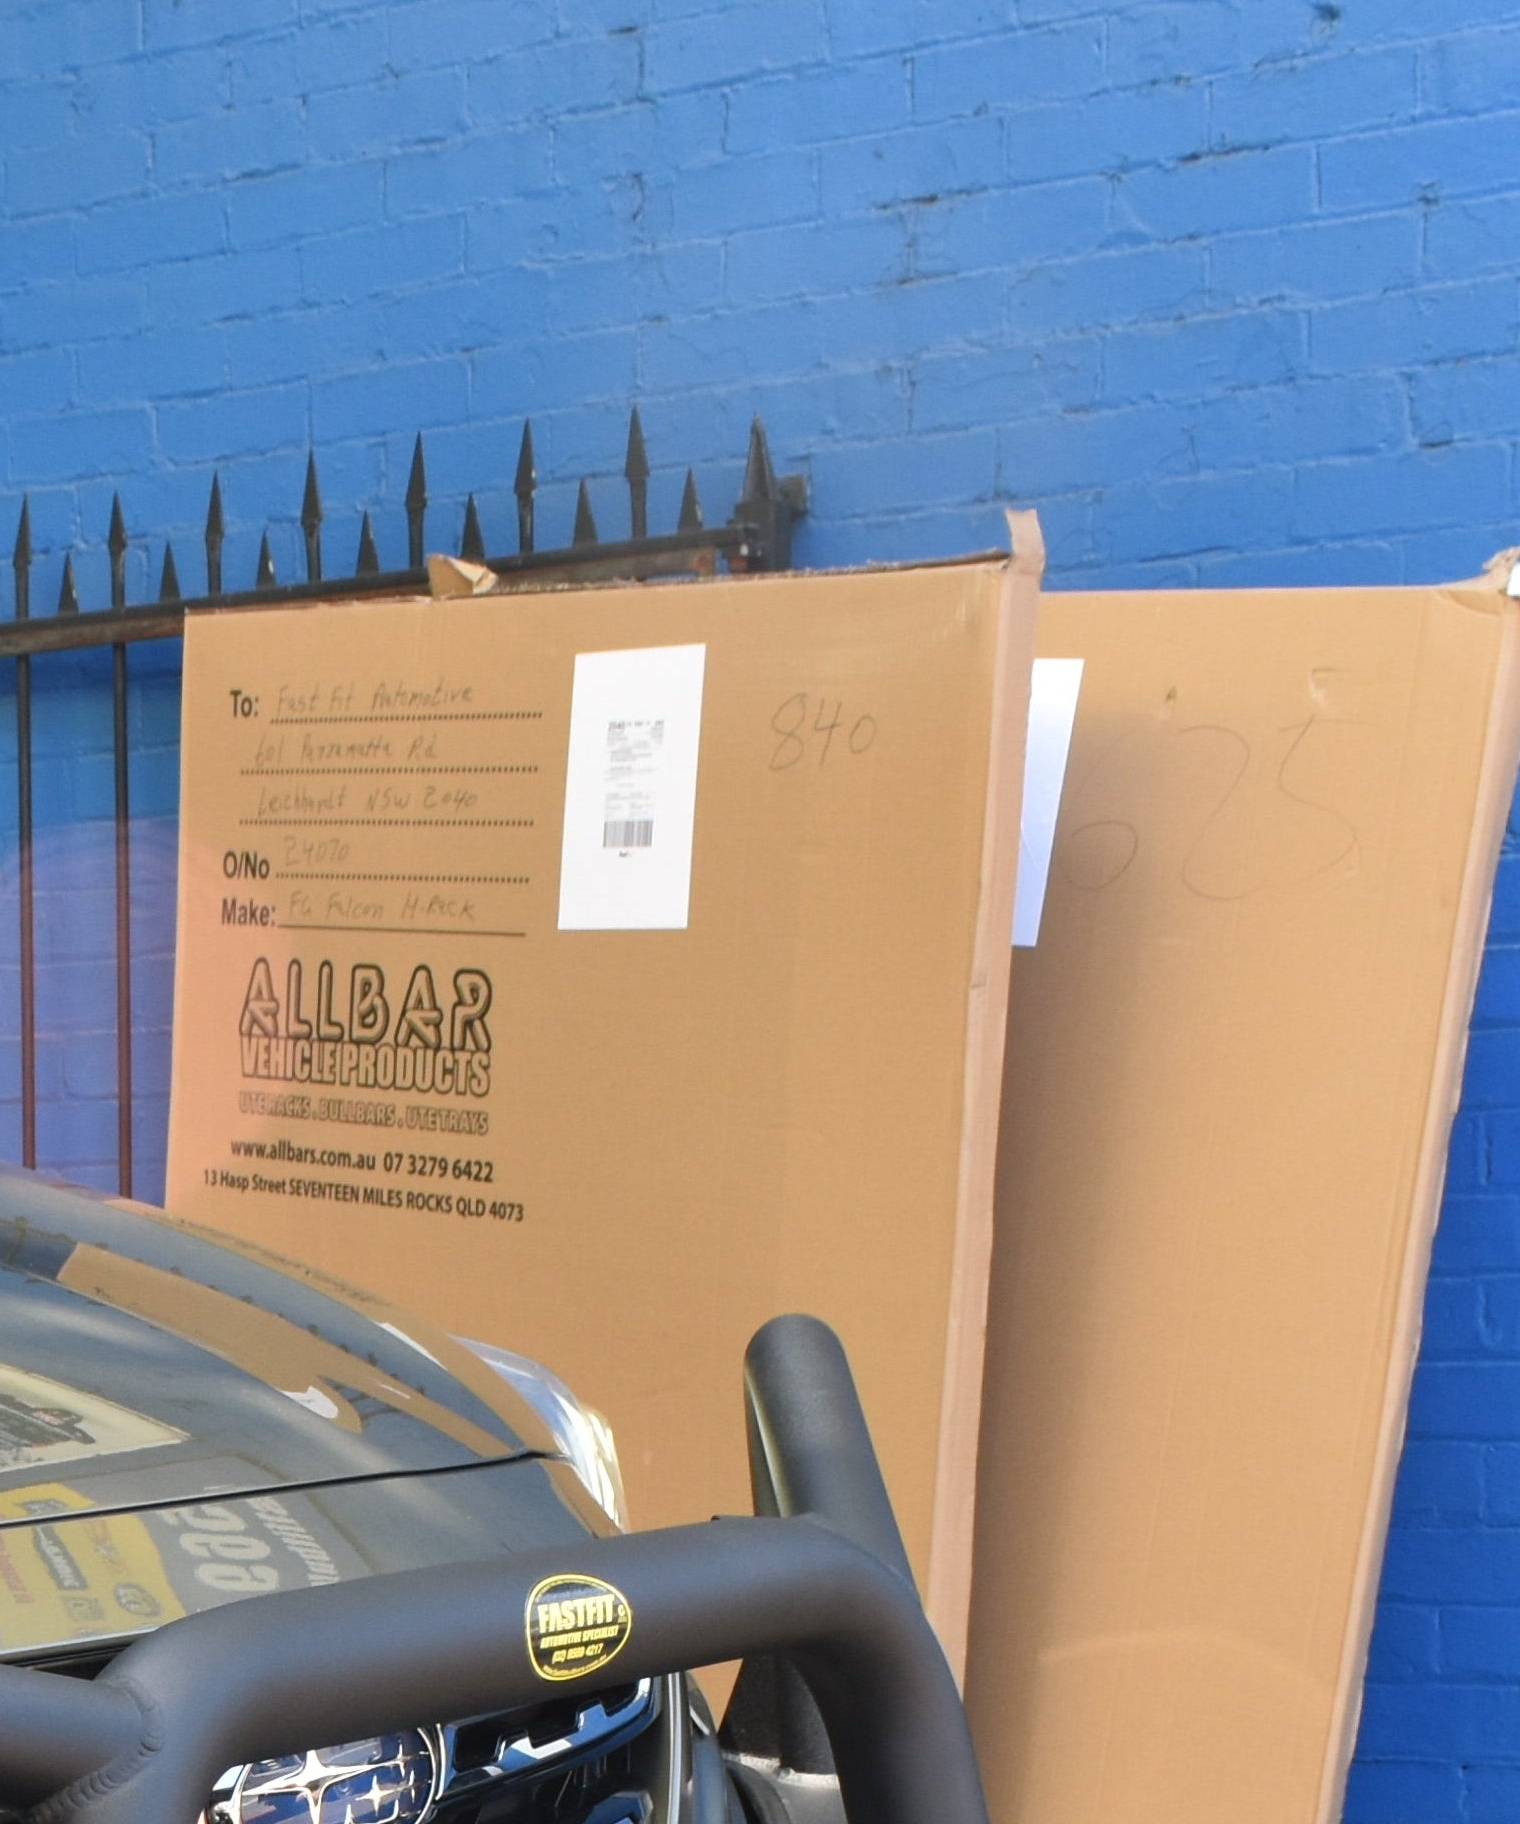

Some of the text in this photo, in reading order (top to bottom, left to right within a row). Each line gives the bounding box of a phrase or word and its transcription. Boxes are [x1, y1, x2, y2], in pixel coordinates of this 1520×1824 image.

[230, 689, 259, 718] To:
[769, 692, 877, 770] 840
[223, 850, 270, 880] O/No
[221, 897, 277, 928] Make:
[238, 956, 493, 1051] ALLBAR
[239, 1034, 491, 1098] VEHICLE PRODUCTS
[230, 1138, 494, 1183] www.allbars.com.au 07 3279 6422
[251, 1173, 287, 1195] Street
[289, 1178, 360, 1203] SEVENTEEN
[362, 1187, 403, 1209] MILES
[406, 1191, 453, 1215] ROCKS
[455, 1196, 487, 1219] QLD
[488, 1200, 525, 1223] 4073
[537, 1593, 615, 1634] FASTFIT
